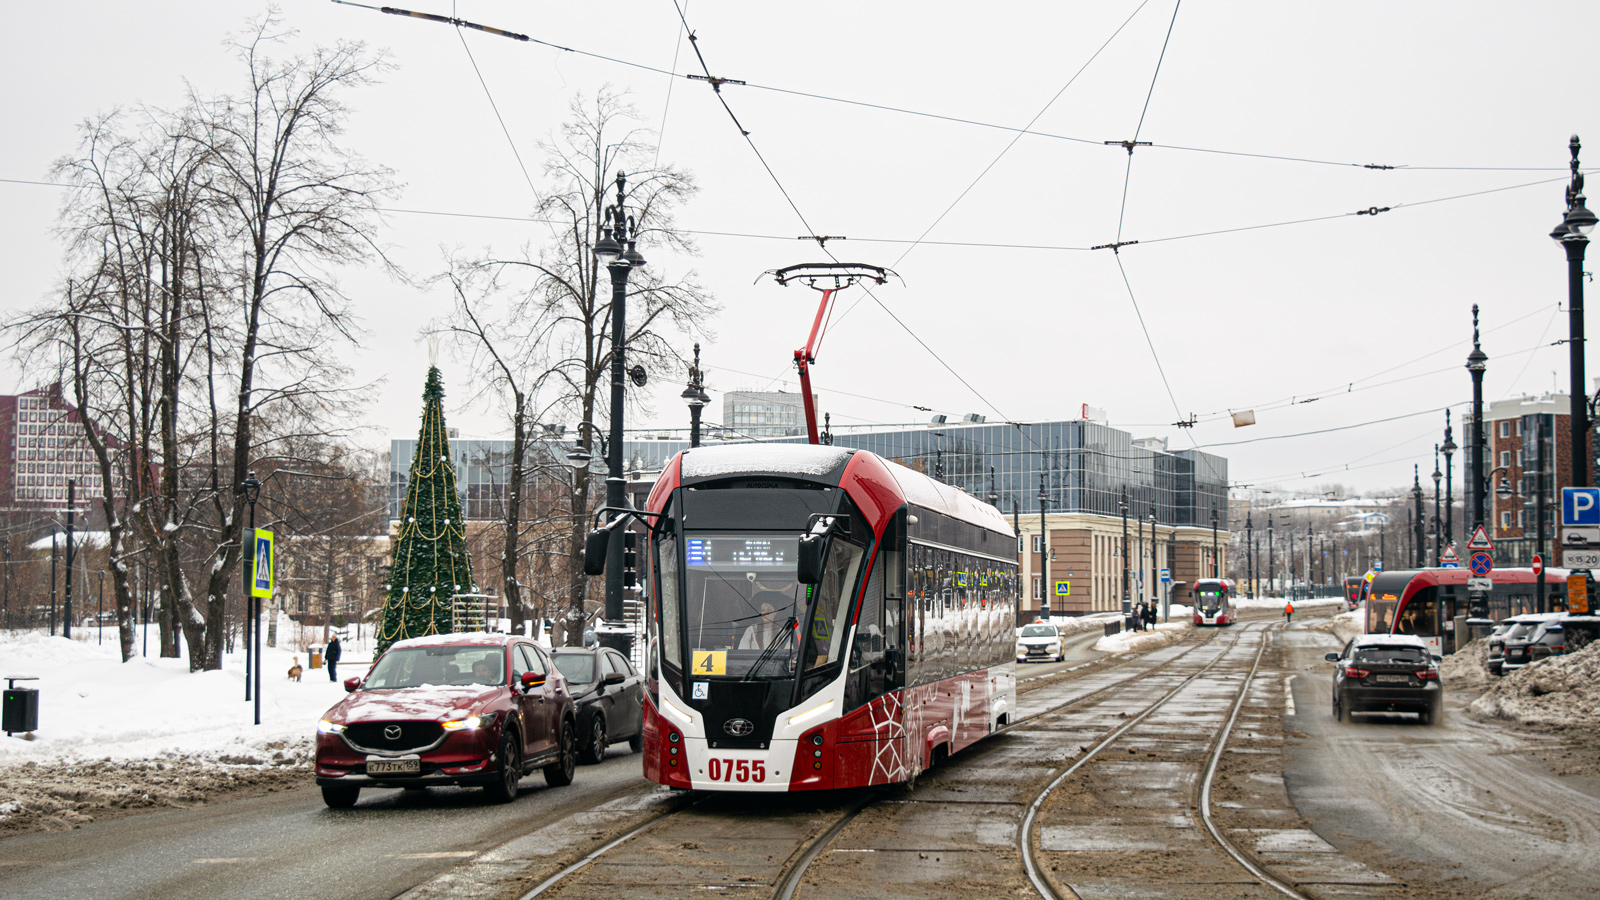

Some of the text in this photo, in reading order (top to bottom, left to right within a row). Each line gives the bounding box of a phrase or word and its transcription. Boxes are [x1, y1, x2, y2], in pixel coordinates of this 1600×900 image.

[1573, 492, 1594, 521] P
[1585, 555, 1598, 564] 20
[700, 653, 714, 672] 4
[708, 758, 766, 783] 0755
